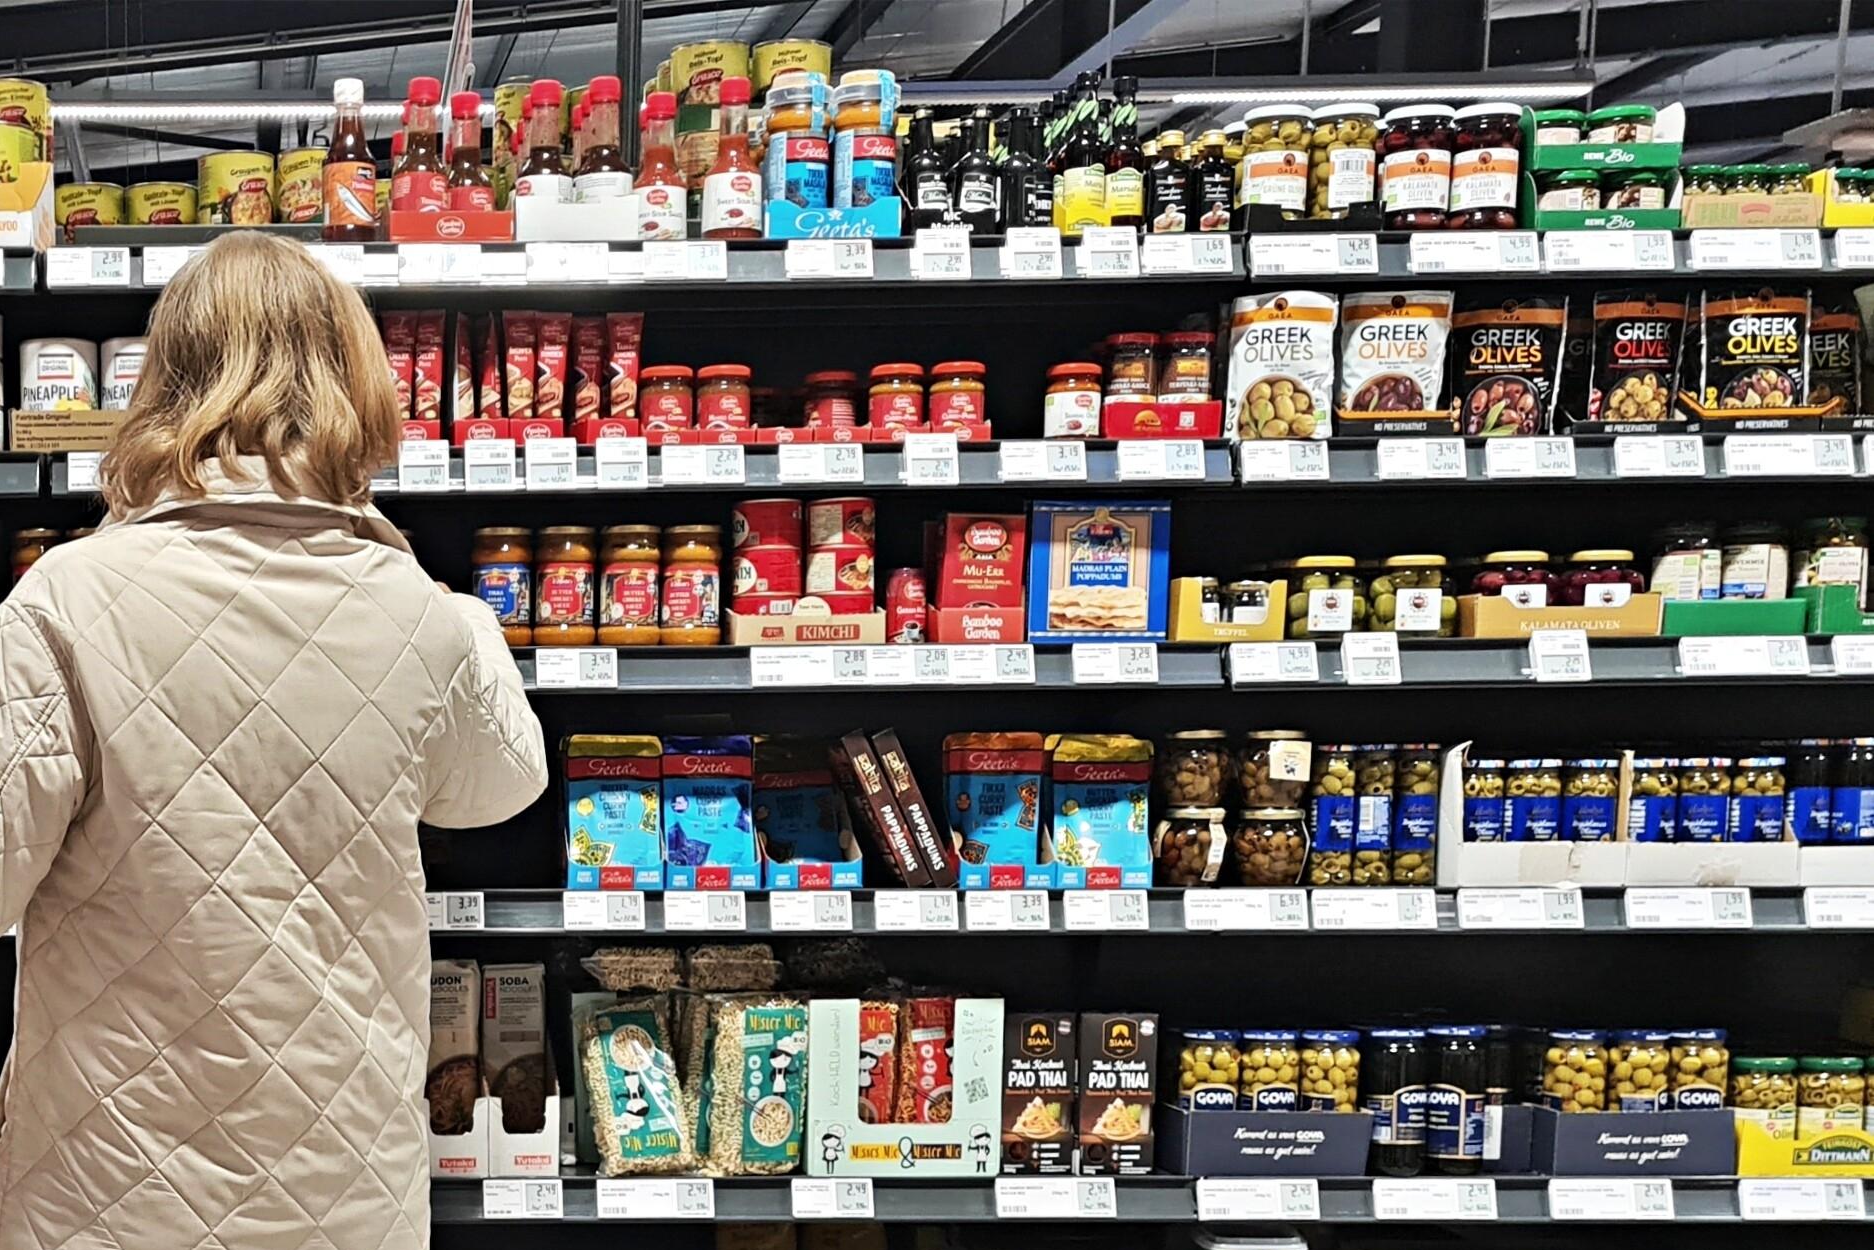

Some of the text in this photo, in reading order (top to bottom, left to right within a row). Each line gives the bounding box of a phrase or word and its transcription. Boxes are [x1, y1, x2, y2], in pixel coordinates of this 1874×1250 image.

[1605, 148, 1635, 164] Bio
[1606, 214, 1635, 230] Bio
[1360, 324, 1430, 341] GREEK
[1616, 322, 1672, 341] GREEK
[1728, 317, 1797, 337] GREEK
[1245, 327, 1312, 345] GREEK
[1471, 328, 1540, 347] GREEK
[1358, 341, 1428, 359] OLIVES
[1614, 339, 1672, 358] OLIVES
[1728, 335, 1797, 354] OLIVES
[1244, 344, 1313, 363] OLIVES
[1470, 346, 1542, 364] OLIVES
[23, 385, 79, 400] PINEAPPLE
[1383, 422, 1427, 432] PRESERVATIVES
[1614, 423, 1657, 433] PRESERVATIVES
[1745, 419, 1789, 429] PRESERVATIVES
[1072, 564, 1128, 573] MADRAS PLAIN
[1076, 573, 1123, 581] POPPADUMS
[962, 615, 1002, 630] Bamboo
[1520, 620, 1621, 632] KALAMATA OLIVEN
[801, 625, 856, 640] KIMCHI
[964, 626, 1001, 642] Garden
[604, 810, 627, 820] PASTE
[698, 807, 722, 817] PASTE
[880, 804, 919, 872] PAPPADUMS
[908, 804, 946, 872] PAPPADUMS
[431, 975, 462, 985] UDON
[499, 976, 529, 985] SOBA
[1008, 1071, 1067, 1087] PAD THAI
[1089, 1072, 1149, 1088] PAD THAI
[1196, 1091, 1234, 1105] GOYA
[1259, 1091, 1295, 1104] GOYA
[1680, 1092, 1721, 1105] GOYA
[1810, 1150, 1870, 1162] DITTMANN
